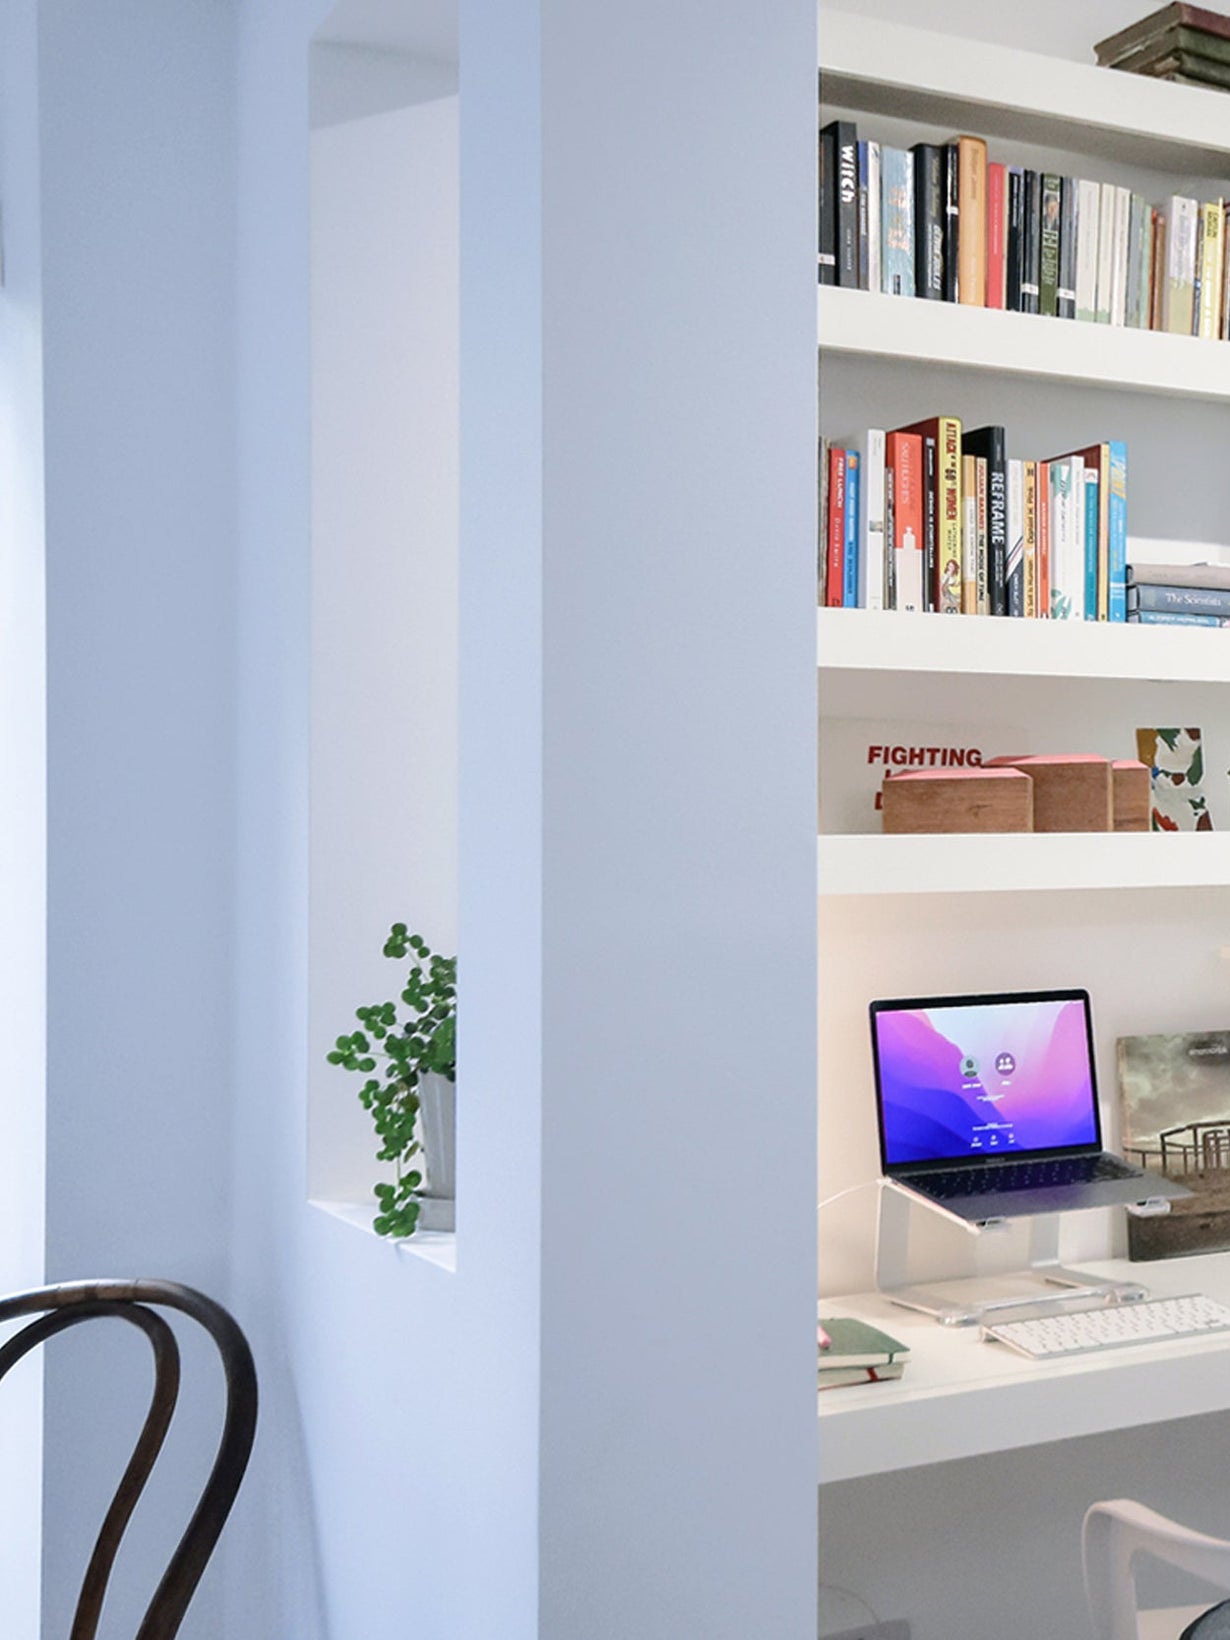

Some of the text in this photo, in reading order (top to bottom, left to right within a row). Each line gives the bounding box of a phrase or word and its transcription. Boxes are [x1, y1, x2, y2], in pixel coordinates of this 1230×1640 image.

[946, 422, 957, 454] ATTACK
[946, 488, 957, 520] WOMEN
[991, 472, 1004, 544] REFRAME
[1165, 593, 1181, 604] The
[1184, 594, 1221, 606] Scientists
[868, 745, 983, 767] FIGHTING
